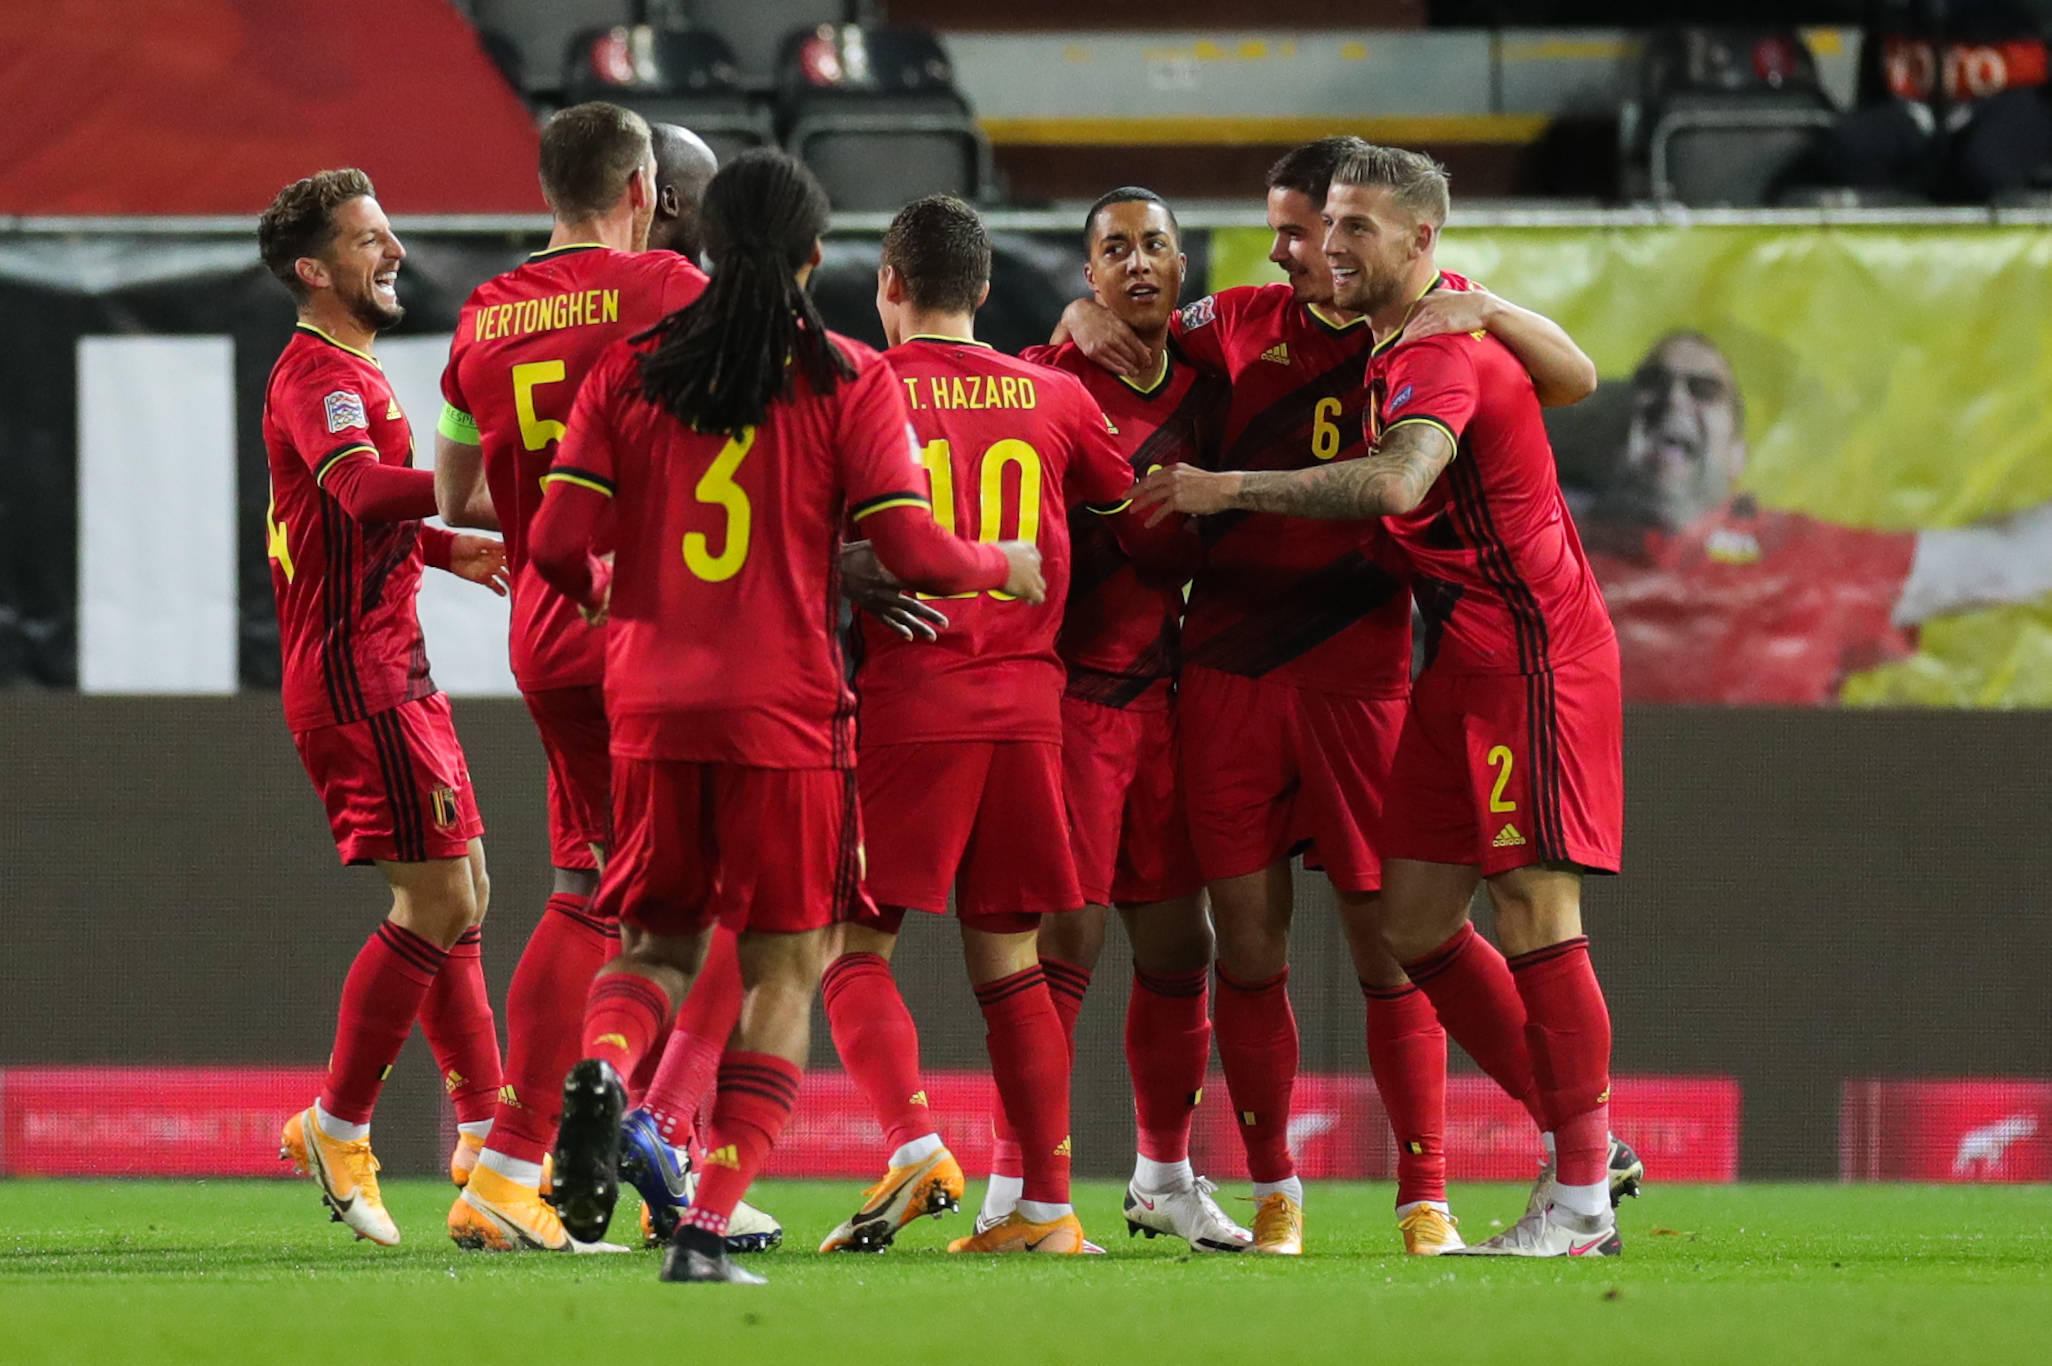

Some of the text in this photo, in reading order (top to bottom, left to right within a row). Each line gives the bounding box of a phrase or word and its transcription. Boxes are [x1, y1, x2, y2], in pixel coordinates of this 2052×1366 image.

[475, 289, 619, 342] VERTONGHEN
[512, 359, 567, 493] 5
[903, 376, 1037, 409] T. HAZARD
[1312, 396, 1342, 460] 6
[682, 425, 756, 582] 3
[915, 438, 1042, 601] 10
[1487, 745, 1517, 813] 2
